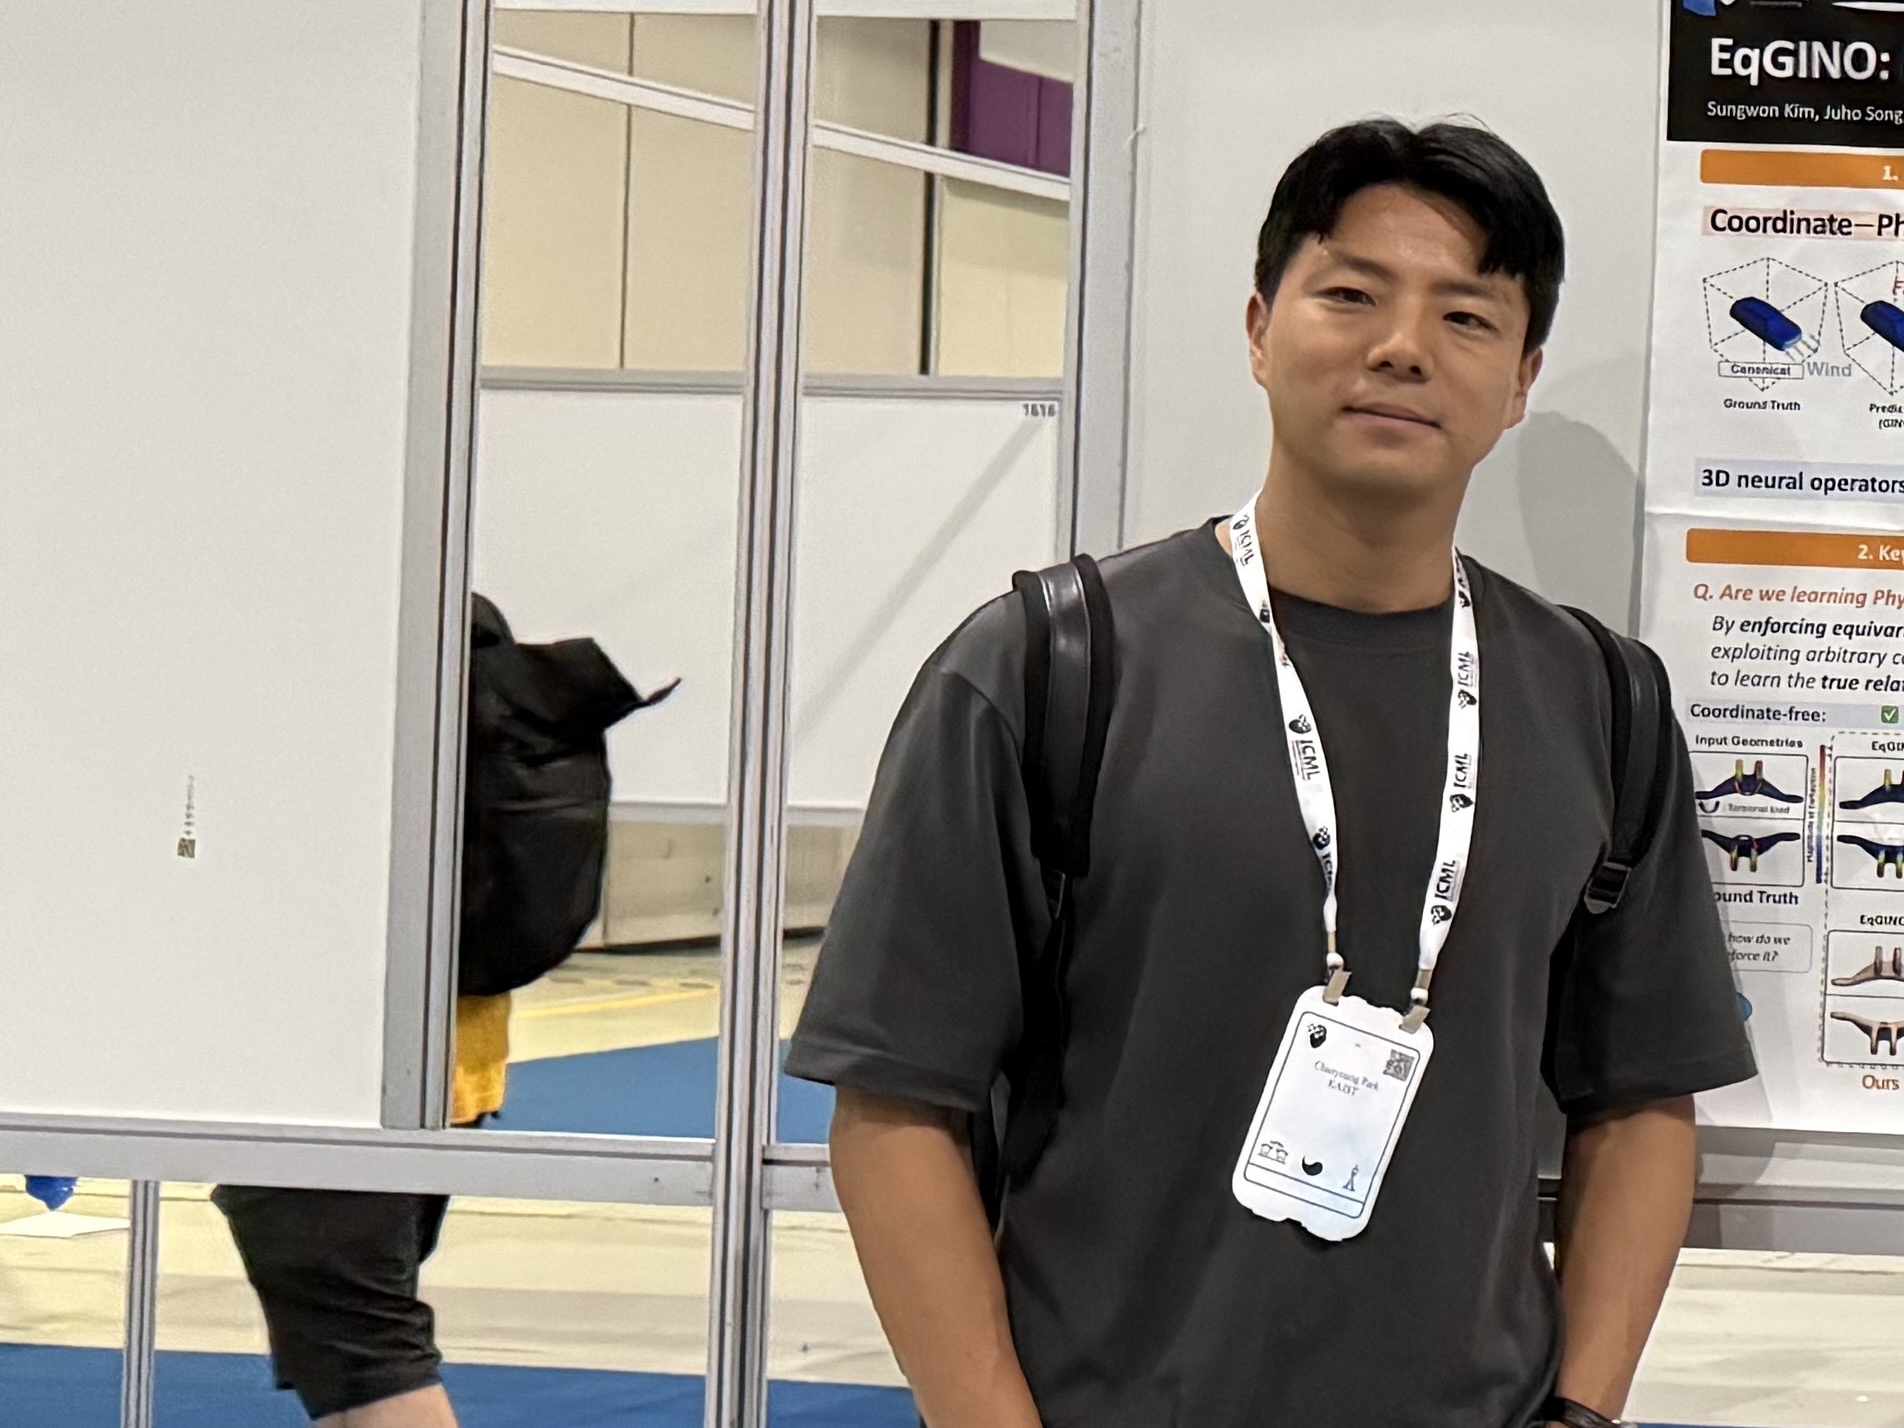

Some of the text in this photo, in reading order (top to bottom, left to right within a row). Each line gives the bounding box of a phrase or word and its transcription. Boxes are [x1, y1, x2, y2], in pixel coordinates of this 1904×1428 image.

[1711, 37, 1890, 86] EqGINO:
[1707, 101, 1779, 120] Sungwon
[1784, 103, 1819, 122] Kim,
[1823, 104, 1862, 121] Juho
[1701, 469, 1729, 487] 3D
[1737, 471, 1803, 490] neural
[1858, 544, 1873, 559] 2.
[1693, 583, 1713, 601] Q.
[1718, 584, 1753, 601] Are
[1759, 589, 1786, 601] we
[1790, 585, 1867, 608] learning
[1712, 615, 1735, 635] By
[1739, 616, 1827, 639] enforcing
[1457, 651, 1472, 688] ICML
[1690, 703, 1825, 722] Coordinate-free:
[1300, 739, 1321, 781] ICML
[1454, 752, 1470, 789] ICML
[1434, 858, 1457, 901] ICML
[1862, 1074, 1899, 1090] Ours
